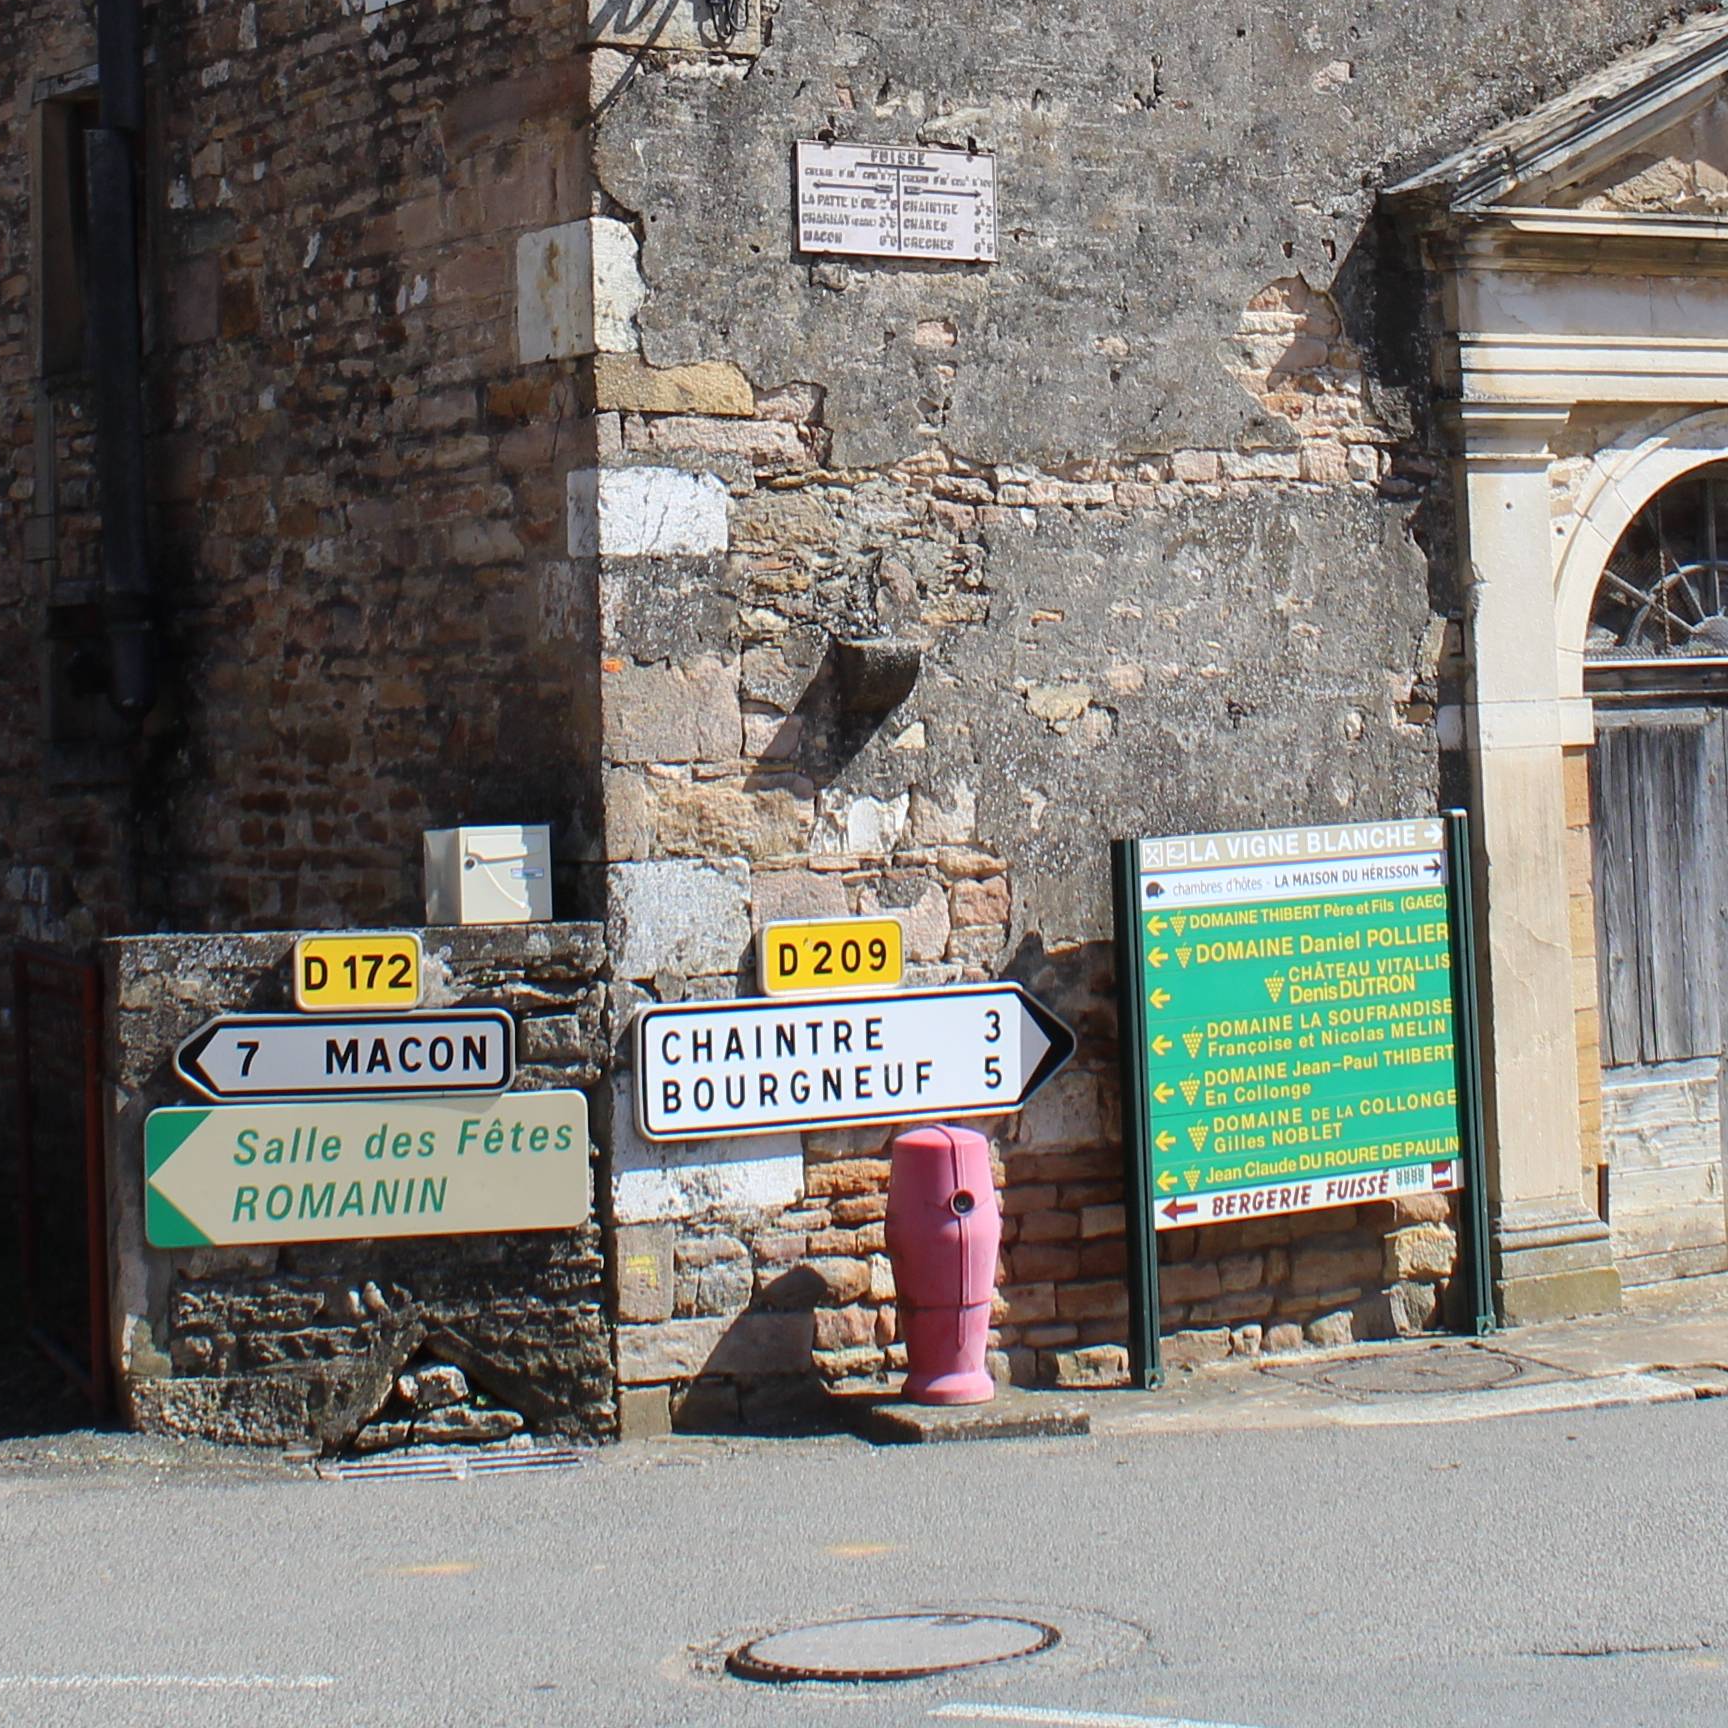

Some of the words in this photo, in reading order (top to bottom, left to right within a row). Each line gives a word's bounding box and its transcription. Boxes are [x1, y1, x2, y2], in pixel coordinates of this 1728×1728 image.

[1189, 839, 1219, 863] LA
[1227, 833, 1299, 859] VIGNE
[1307, 824, 1416, 854] BLANCHE
[1173, 878, 1222, 896] chambres
[1227, 873, 1263, 892] d'hôtes
[1274, 874, 1290, 888] LA
[1293, 871, 1339, 886] MAISON
[1342, 869, 1358, 882] DU
[1361, 863, 1419, 880] HÉRISSON
[1189, 910, 1258, 929] DOMAINE
[1260, 904, 1321, 923] THIBERT
[1324, 902, 1354, 919] Père
[1355, 901, 1370, 916] et
[1372, 897, 1394, 913] Fils
[1401, 893, 1447, 914] (GAEC)
[779, 942, 798, 977] D
[813, 937, 887, 975] 209
[1196, 937, 1293, 964] DOMAINE
[1300, 931, 1360, 954] Daniel
[1367, 923, 1449, 948] POLLIER
[304, 955, 328, 991] D
[343, 953, 412, 990] 172
[1288, 958, 1370, 984] CHÂTEAU
[1377, 952, 1450, 975] VITALLIS
[1289, 982, 1337, 1005] Denis
[1340, 974, 1415, 999] DUTRON
[661, 1017, 883, 1065] CHAINTRE
[984, 1010, 1002, 1043] 3
[1207, 1015, 1293, 1038] DOMAINE
[1301, 1012, 1321, 1029] LA
[1328, 998, 1453, 1026] SOUFRANDISE
[1208, 1035, 1293, 1057] Françoise
[1299, 1033, 1314, 1048] et
[1322, 1026, 1384, 1046] Nicolas
[1391, 1019, 1446, 1038] MELIN
[236, 1040, 260, 1077] 7
[325, 1035, 488, 1075] MACON
[1204, 1062, 1287, 1087] DOMAINE
[1293, 1049, 1378, 1077] Jean-Paul
[1383, 1044, 1455, 1067] THIBERT
[662, 1061, 932, 1115] BOURGNEUF
[984, 1056, 1002, 1089] 5
[1205, 1091, 1227, 1106] En
[1234, 1082, 1311, 1104] Collonge
[1213, 1108, 1302, 1134] DOMAINE
[1311, 1107, 1331, 1121] DE
[1337, 1105, 1353, 1119] LA
[1360, 1089, 1457, 1116] COLLONGE
[233, 1127, 342, 1167] Salle
[364, 1123, 436, 1160] des
[457, 1119, 574, 1156] Fêtes
[1214, 1133, 1265, 1154] Gilles
[1272, 1122, 1343, 1146] NOBLET
[1205, 1165, 1242, 1184] Jean
[1245, 1157, 1297, 1179] Claude
[1299, 1155, 1322, 1171] DU
[1325, 1147, 1379, 1168] ROURE
[1382, 1144, 1403, 1161] DE
[1405, 1136, 1459, 1156] PAULIN
[231, 1176, 448, 1222] ROMANIN
[1212, 1185, 1312, 1217] BERGERIE
[1326, 1170, 1390, 1201] FUISSÉ
